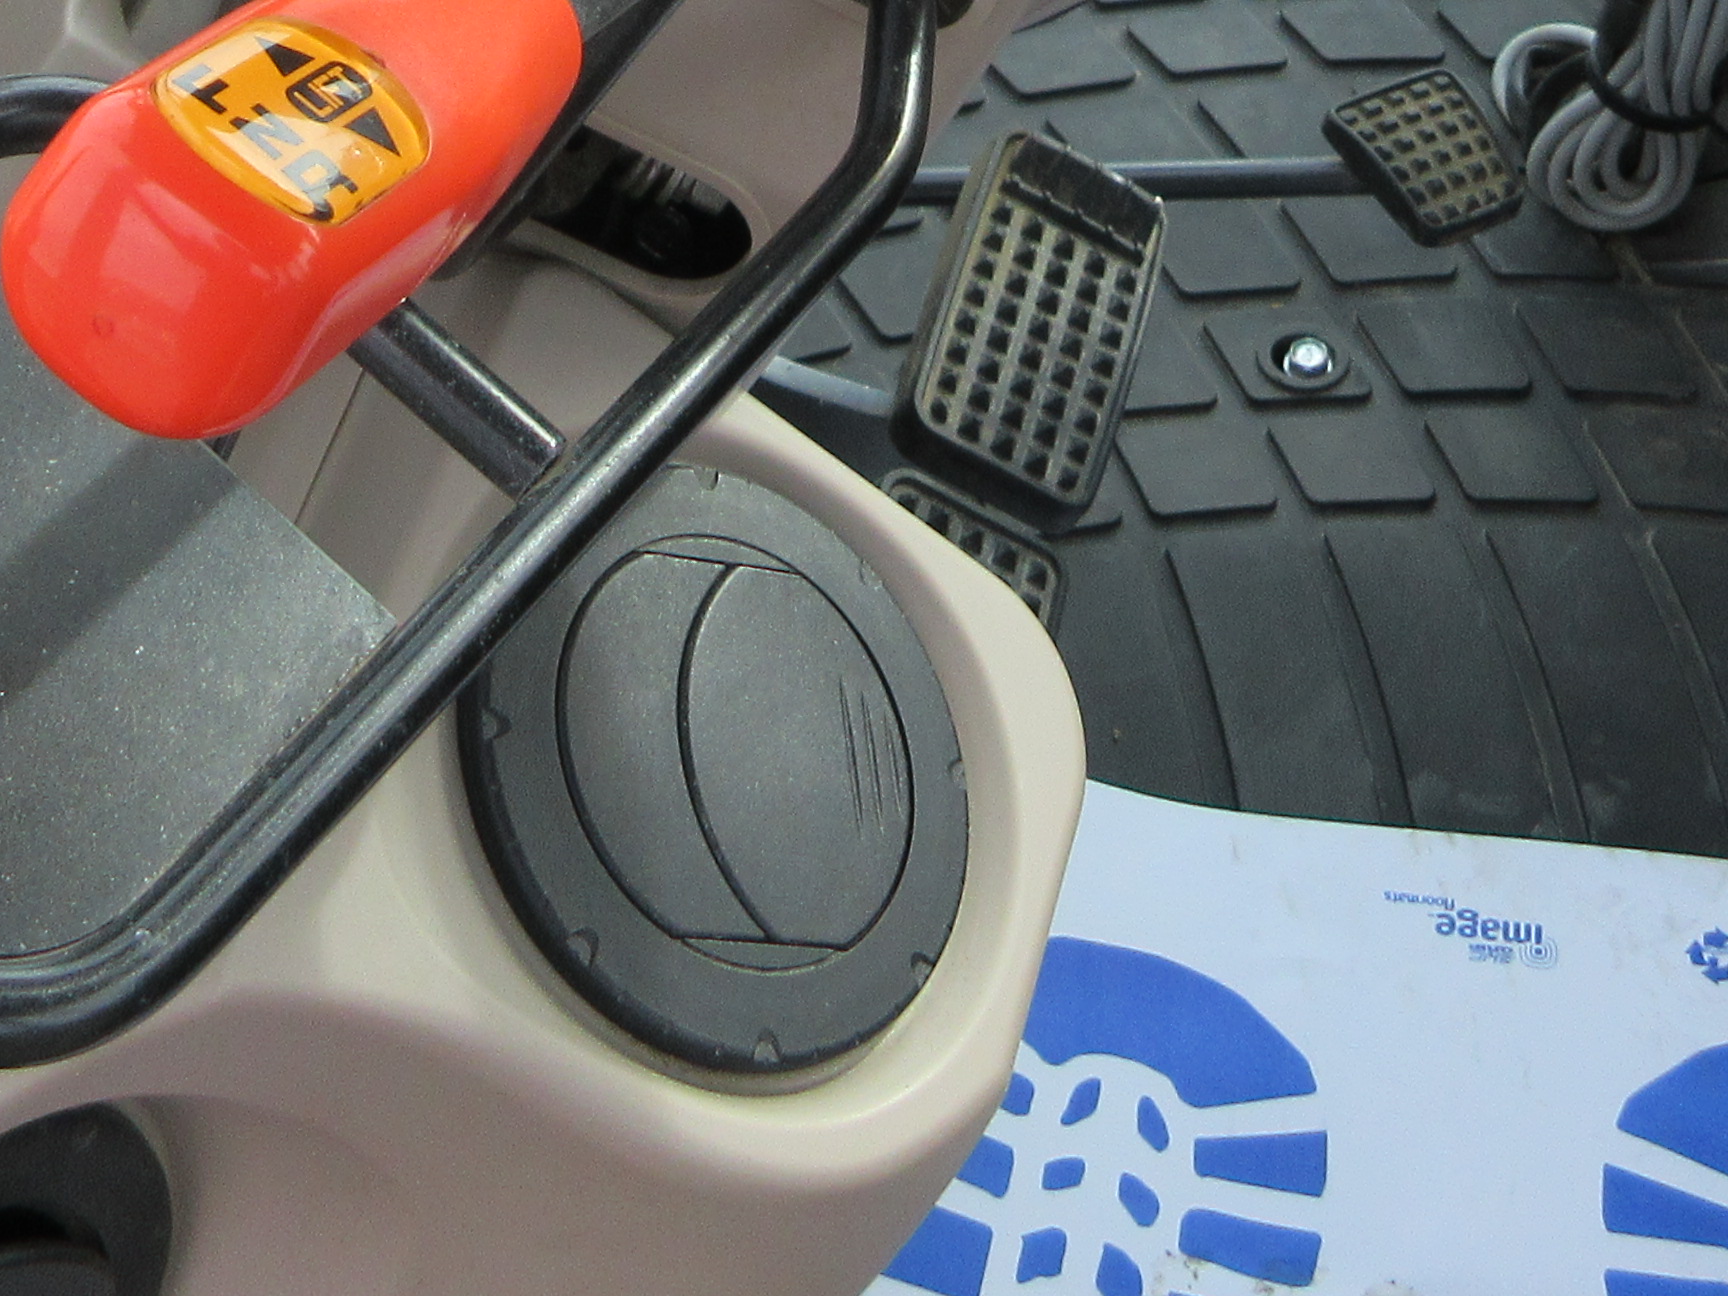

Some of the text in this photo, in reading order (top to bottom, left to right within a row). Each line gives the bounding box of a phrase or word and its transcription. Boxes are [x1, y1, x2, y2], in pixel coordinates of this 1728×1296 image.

[172, 63, 229, 114] F
[293, 65, 363, 114] LIFT
[230, 103, 304, 160] N
[1383, 890, 1455, 911] floormats
[1435, 908, 1543, 946] image
